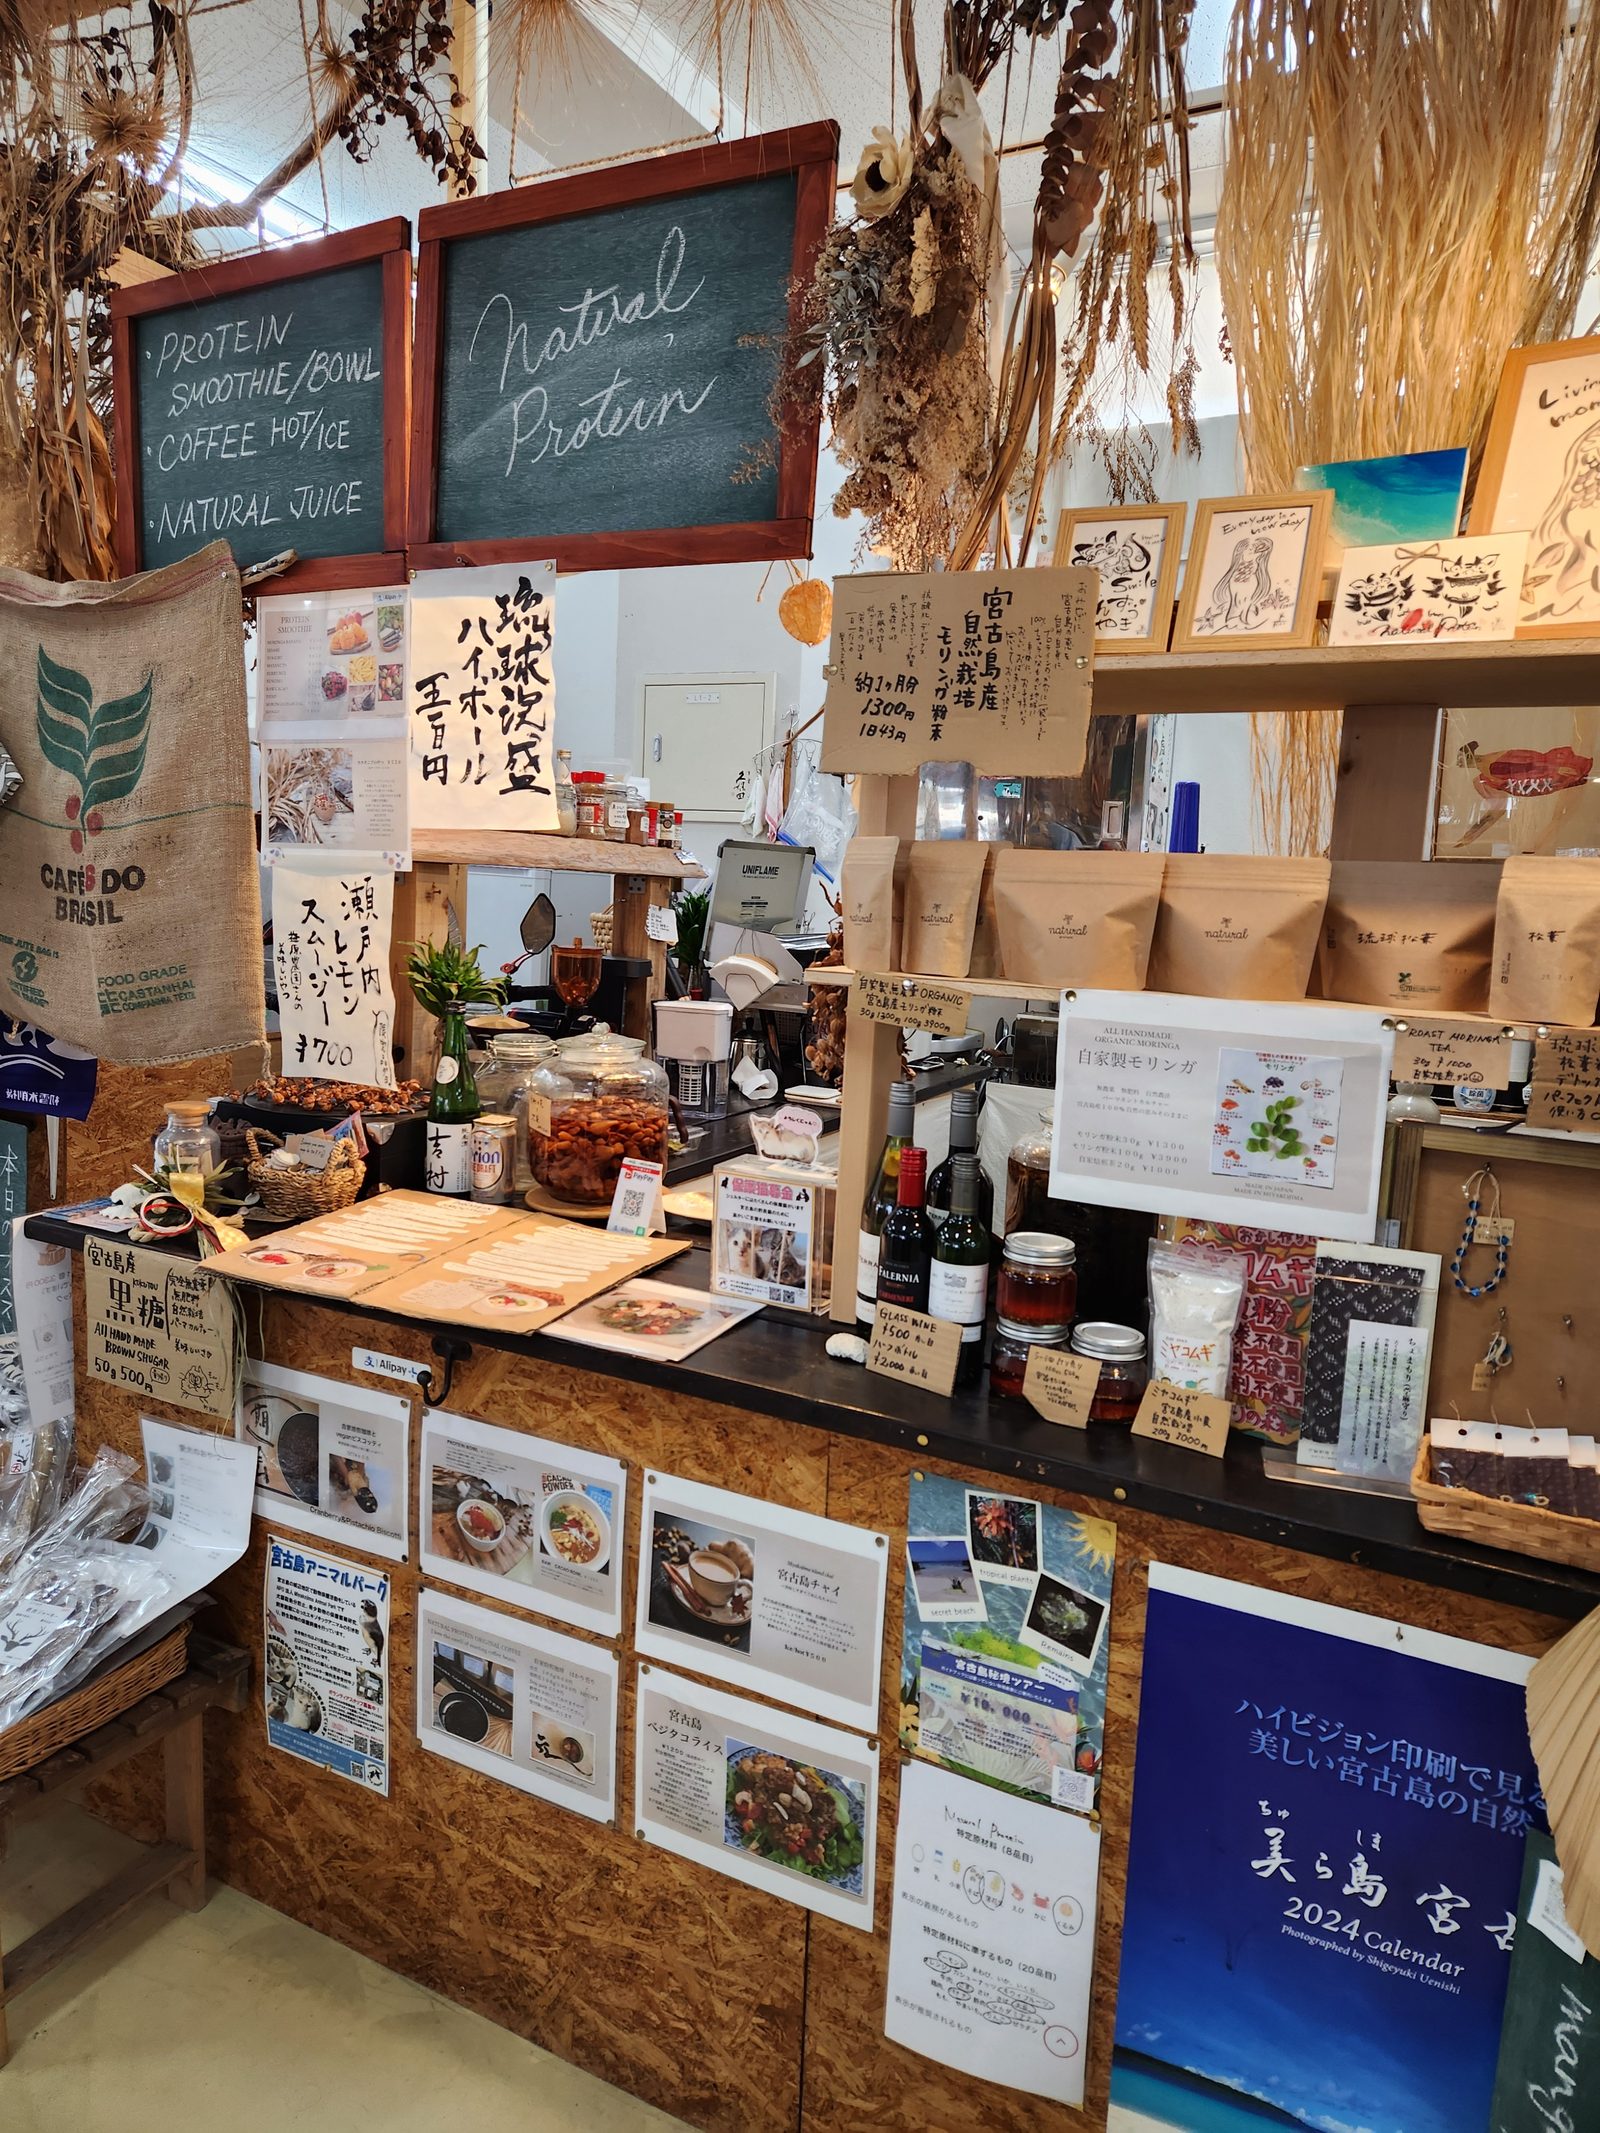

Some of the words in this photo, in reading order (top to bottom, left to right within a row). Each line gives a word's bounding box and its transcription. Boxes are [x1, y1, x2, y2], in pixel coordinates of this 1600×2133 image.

[469, 226, 705, 393] Natural
[156, 312, 294, 378] PROTEIN
[168, 347, 381, 418] SMOOTHIE/BOWL
[505, 362, 719, 477] Protein
[158, 422, 257, 471] COFFEE
[270, 407, 350, 451] HOT/ICE
[157, 494, 282, 543] NATURAL
[290, 480, 362, 519] JUICE
[1111, 571, 1157, 593] Smile
[953, 610, 983, 708] 自然栽培
[978, 586, 1014, 711] 宮古島産
[930, 625, 953, 741] モリンガ粉末
[861, 698, 915, 720] 1300円
[859, 723, 907, 743] 1日43円
[40, 864, 85, 895] CAFÉ
[101, 863, 146, 894] DO
[742, 865, 780, 876] UNIFLAME
[55, 898, 124, 926] BRASIL
[921, 914, 954, 924] natural
[341, 876, 382, 995] 瀬戸内
[1048, 924, 1088, 937] natural
[1204, 927, 1248, 941] natural
[1528, 930, 1566, 943] 松葉
[301, 899, 334, 1026] スムージー
[335, 930, 359, 1015] レモン
[97, 972, 135, 988] FOOD
[139, 964, 188, 982] GRADE
[920, 988, 964, 1006] ORGANIC
[1095, 1036, 1135, 1047] ORGANIC
[1136, 1040, 1181, 1051] MORINGA
[1104, 1027, 1122, 1036] ALL
[1123, 1029, 1174, 1041] HANDMADE
[1409, 1028, 1445, 1039] ROAST
[1450, 1032, 1501, 1045] MORINGA
[295, 1033, 353, 1067] ¥700
[1078, 1048, 1198, 1075] 自家製モリンガ
[1265, 1063, 1295, 1072] モリンガ
[473, 1151, 500, 1164] rion
[633, 1172, 655, 1183] PayPay
[87, 1243, 136, 1274] 宮古島産
[878, 1264, 920, 1284] FALERNIA
[105, 1277, 165, 1330] 黒糖
[879, 1306, 909, 1323] GLASS
[911, 1317, 938, 1333] WINE
[882, 1323, 911, 1340] ¥500
[105, 1340, 136, 1359] BROWN
[1160, 1337, 1216, 1362] ミヤコムギ
[95, 1357, 117, 1379] 50g
[120, 1366, 154, 1393] 500円
[379, 1359, 408, 1377] Alipay
[1151, 1385, 1199, 1407] ミヤコムギ
[542, 1481, 575, 1492] POWDER
[309, 1506, 376, 1532] Cranberry&Pistachio
[271, 1545, 388, 1602] 宮古島アニマルパーク
[778, 1569, 841, 1597] 宮古島チャイ
[979, 1567, 1008, 1582] tropical
[1010, 1574, 1034, 1585] plants
[931, 1607, 953, 1616] secret
[954, 1606, 976, 1615] beach
[955, 1659, 1045, 1691] 宮古島秘境ツアー
[669, 1709, 702, 1731] 宮古島
[647, 1721, 724, 1755] ベジタコライス
[1248, 1729, 1535, 1838] 美しい宮古島の自然
[1258, 1800, 1291, 1820] ちゅ
[956, 1828, 1034, 1864] 特定原材料（8品目）
[1356, 1829, 1383, 1851] しま
[1283, 1896, 1360, 1941] 2024
[1363, 1931, 1465, 1979] Calendar
[923, 1925, 1058, 1982] 特定原材料に準ずるもの（20品目）
[1280, 1923, 1351, 1957] Photographed
[1352, 1945, 1365, 1962] by
[1366, 1954, 1417, 1982] Shigeyuki
[1419, 1972, 1461, 1995] Uenishi
